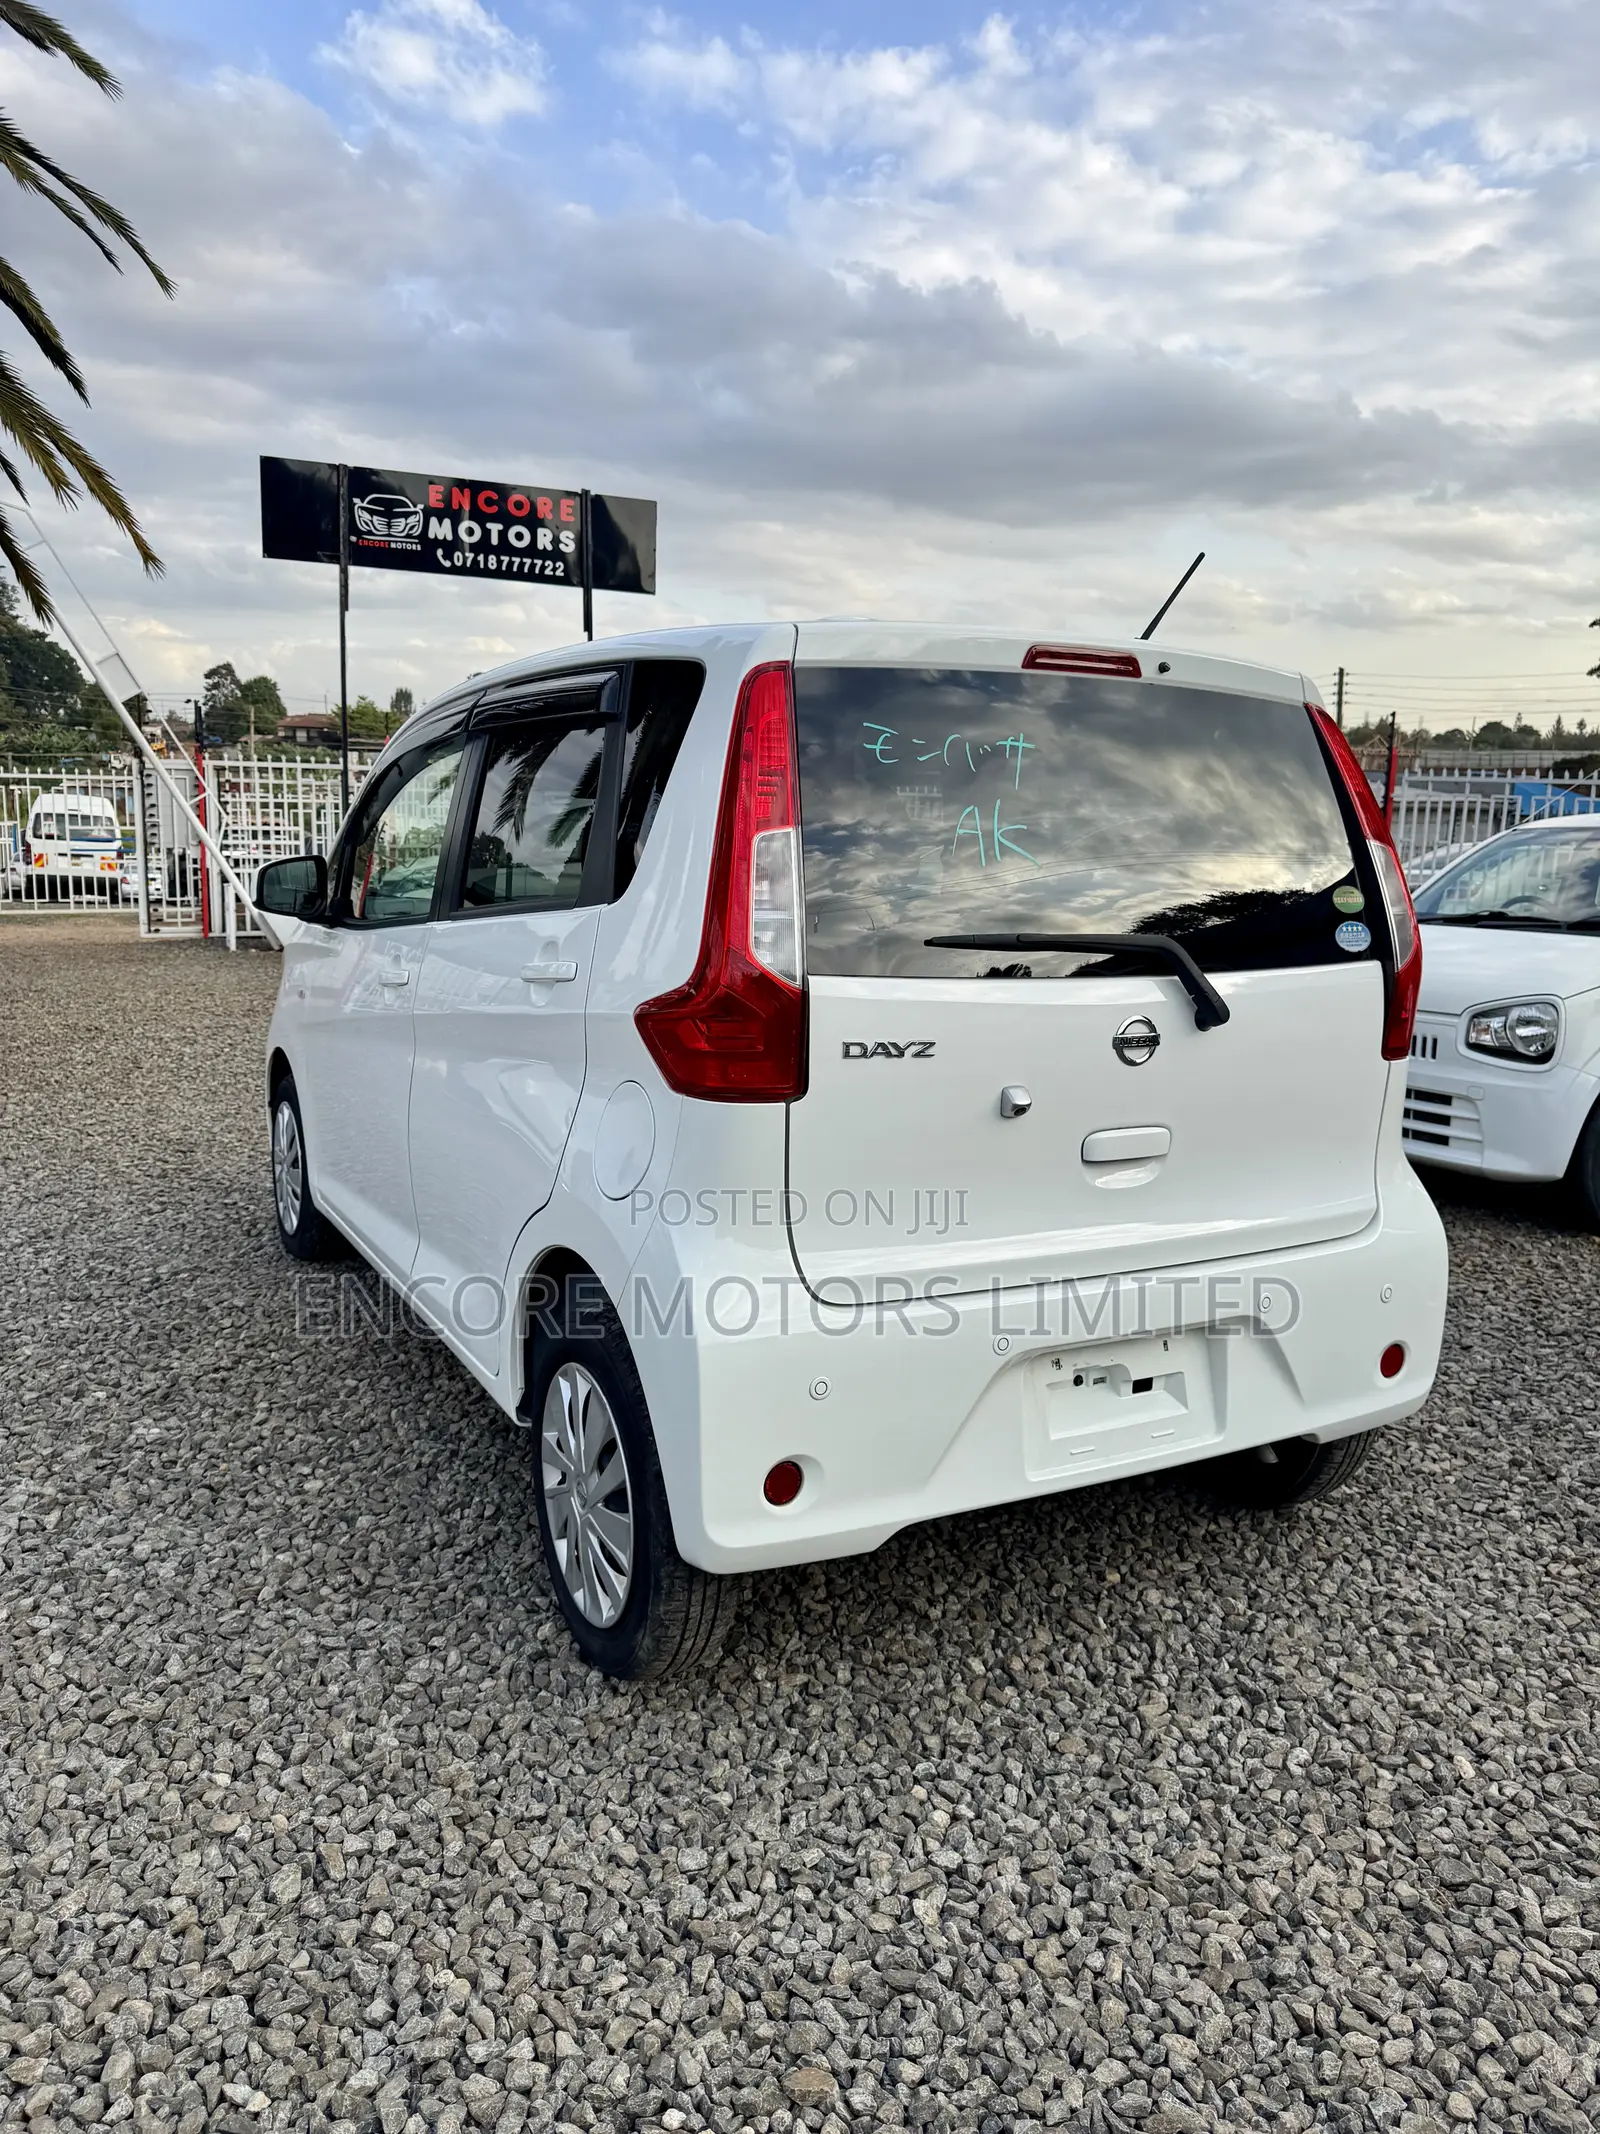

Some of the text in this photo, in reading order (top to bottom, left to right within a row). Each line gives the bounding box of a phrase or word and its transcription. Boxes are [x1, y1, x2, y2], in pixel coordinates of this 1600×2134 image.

[428, 484, 576, 522] ENCORE
[358, 539, 422, 551] ENCORE MOTORS
[428, 516, 576, 554] MOTORS
[453, 551, 565, 577] 0718777722
[842, 1040, 936, 1059] DAYZ
[1118, 1035, 1159, 1047] NISSAN
